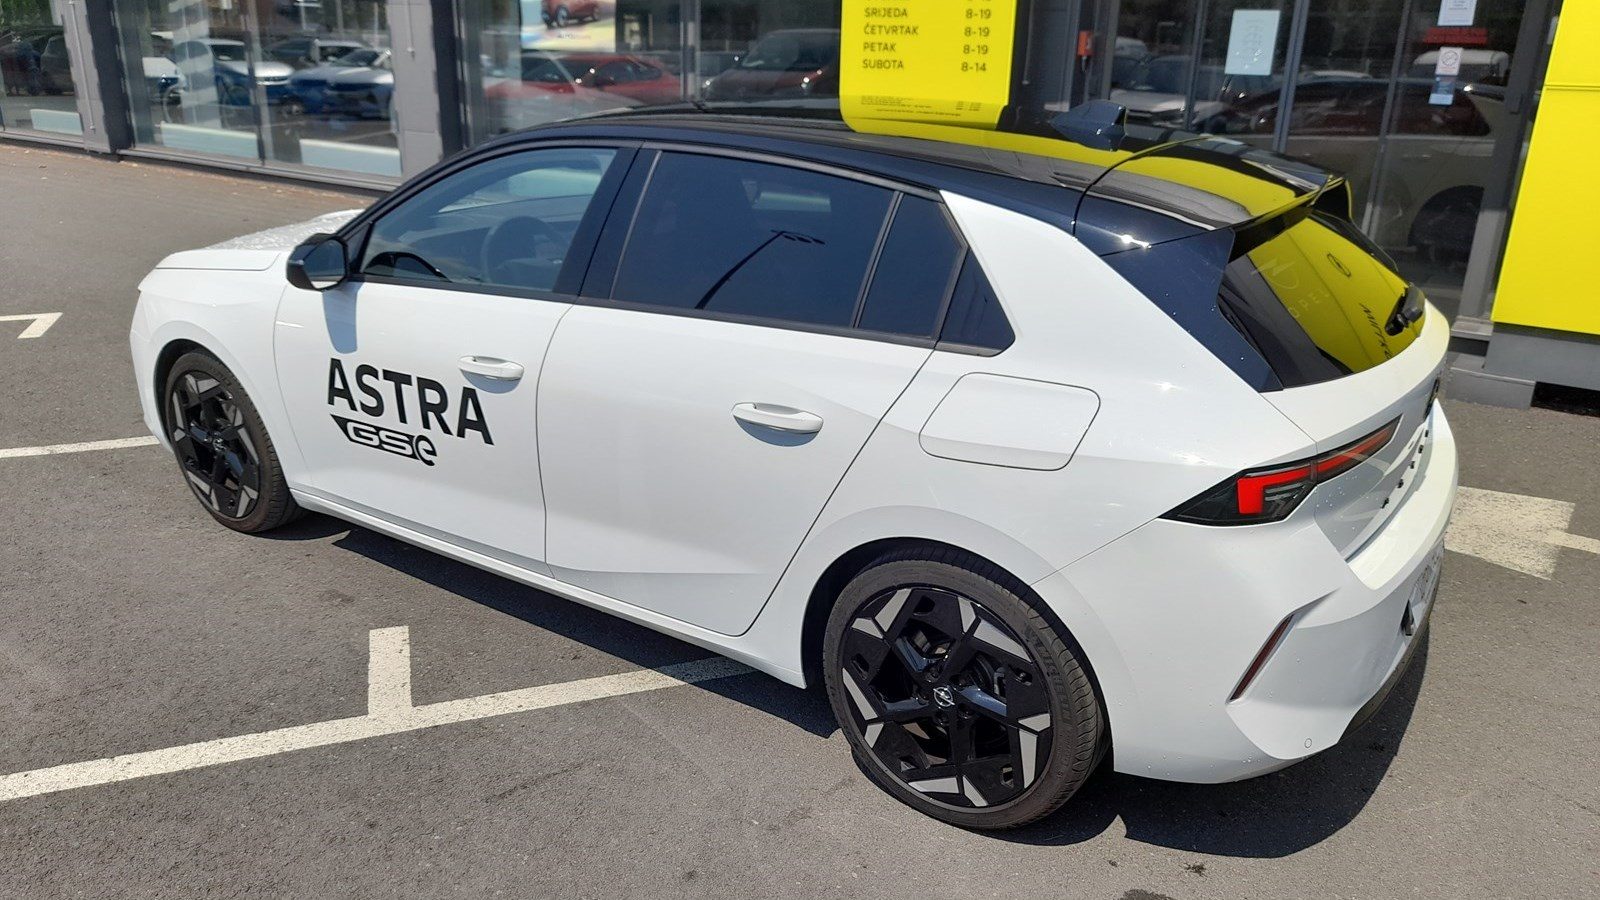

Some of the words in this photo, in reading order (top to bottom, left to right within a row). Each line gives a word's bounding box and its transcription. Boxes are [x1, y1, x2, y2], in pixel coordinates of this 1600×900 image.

[865, 8, 907, 17] SRIJEDA
[966, 9, 991, 19] 8-19
[864, 23, 918, 34] ČETVRTAK
[965, 27, 989, 37] 8-19
[864, 42, 896, 51] PETAK
[963, 45, 988, 54] 8-19
[863, 59, 903, 69] SUBOTA
[962, 62, 986, 71] 8-14
[327, 357, 495, 446] ASTRA
